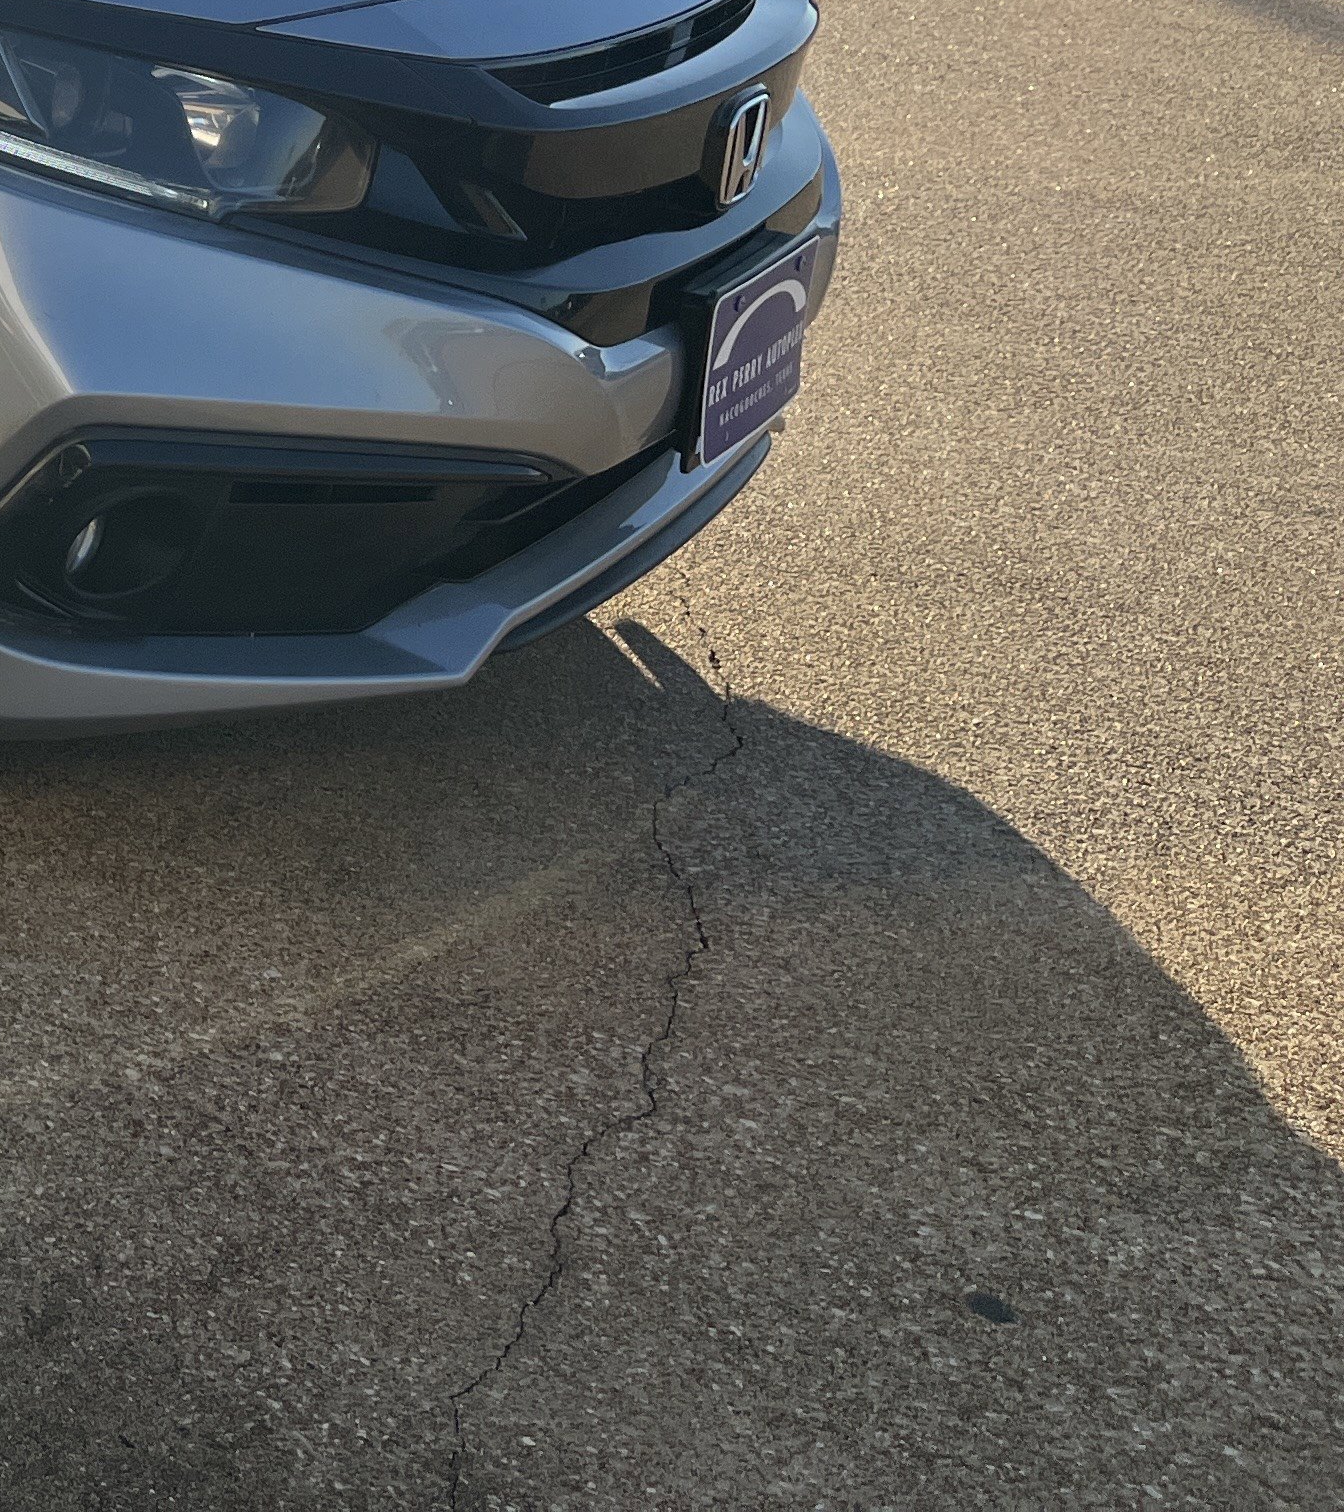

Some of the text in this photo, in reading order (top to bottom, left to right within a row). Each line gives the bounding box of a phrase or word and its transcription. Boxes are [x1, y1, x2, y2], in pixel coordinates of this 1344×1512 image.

[708, 319, 803, 407] REX PERRY AUTOPLEX
